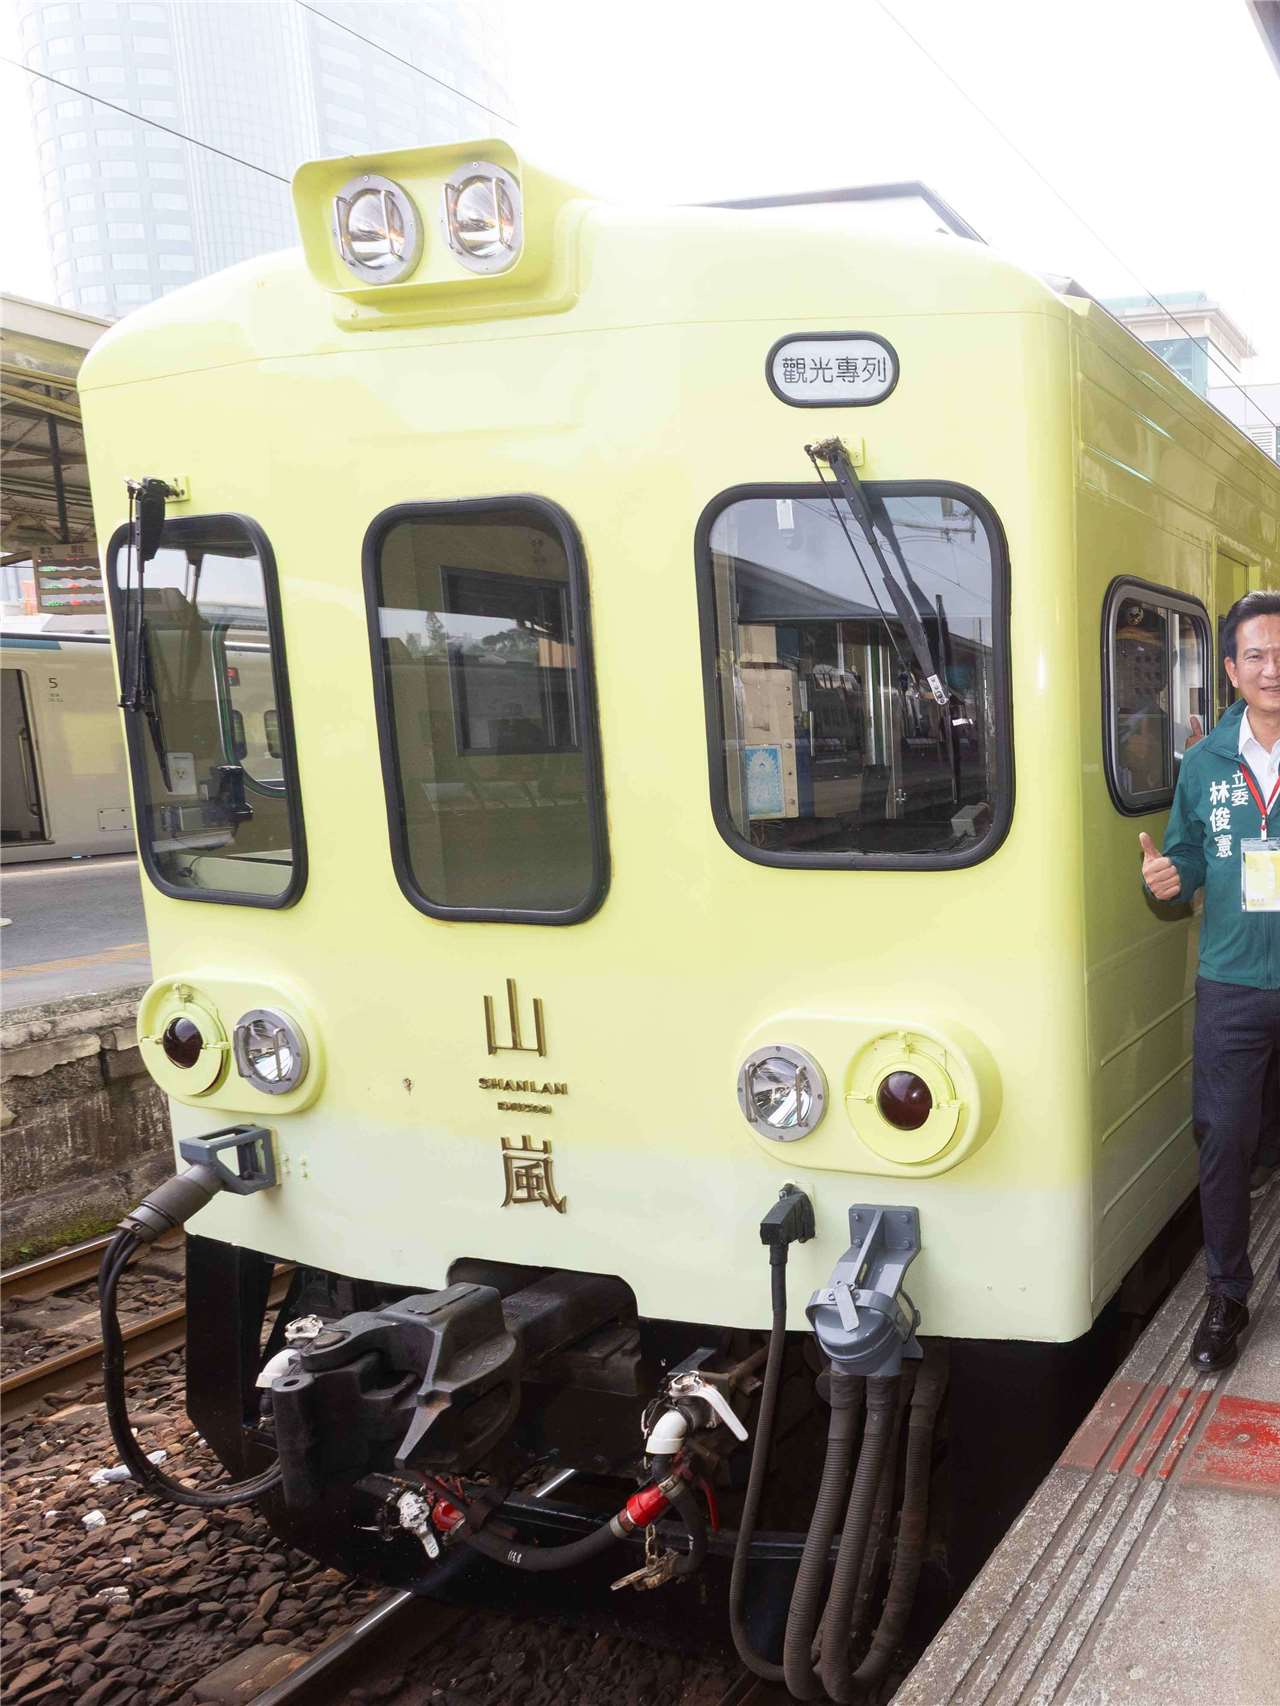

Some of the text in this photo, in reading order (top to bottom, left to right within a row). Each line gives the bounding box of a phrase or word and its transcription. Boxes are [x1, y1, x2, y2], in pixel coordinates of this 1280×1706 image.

[782, 356, 887, 384] 觀光專列
[49, 677, 58, 689] 5
[1231, 770, 1249, 807] 立委
[1209, 780, 1233, 858] 林俊憲
[483, 978, 548, 1058] 山
[478, 1077, 568, 1096] SHANLAN
[500, 1134, 567, 1214] 嵐
